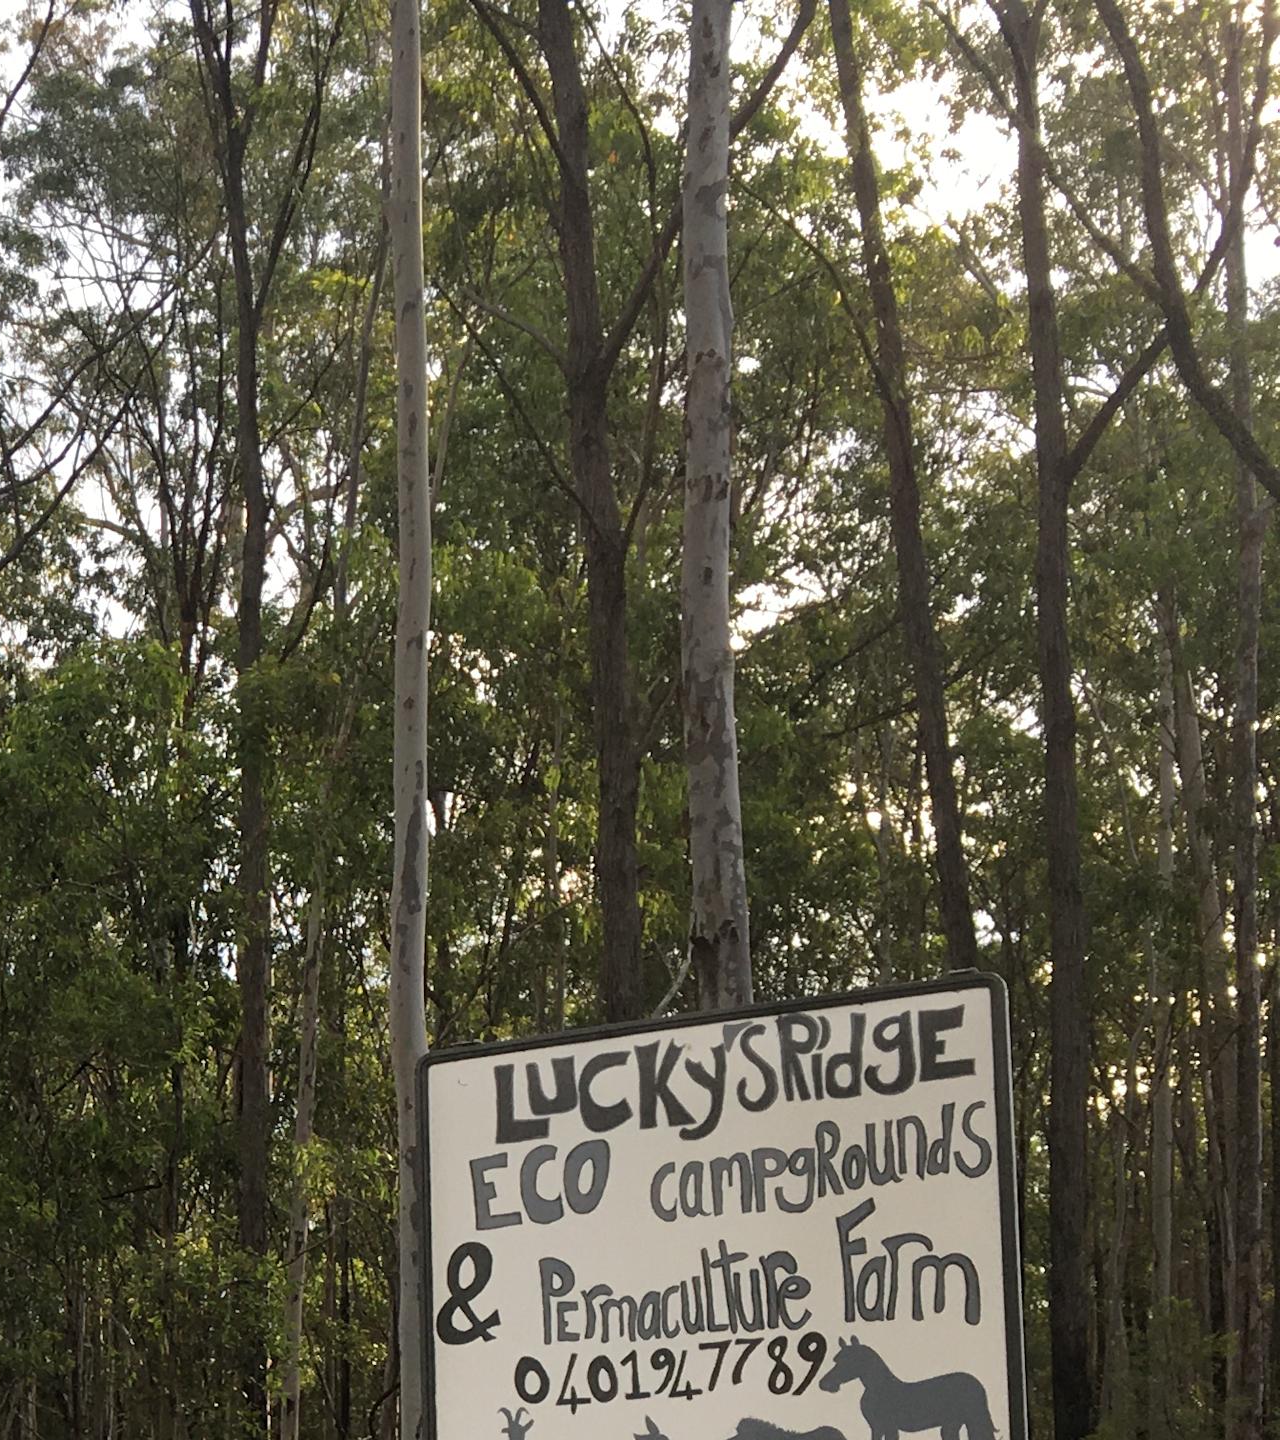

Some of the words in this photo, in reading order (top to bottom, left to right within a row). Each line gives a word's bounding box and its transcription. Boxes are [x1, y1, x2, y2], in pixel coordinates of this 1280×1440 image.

[469, 1139, 611, 1231] ECO
[435, 1241, 502, 1345] &
[834, 1198, 982, 1326] Farm
